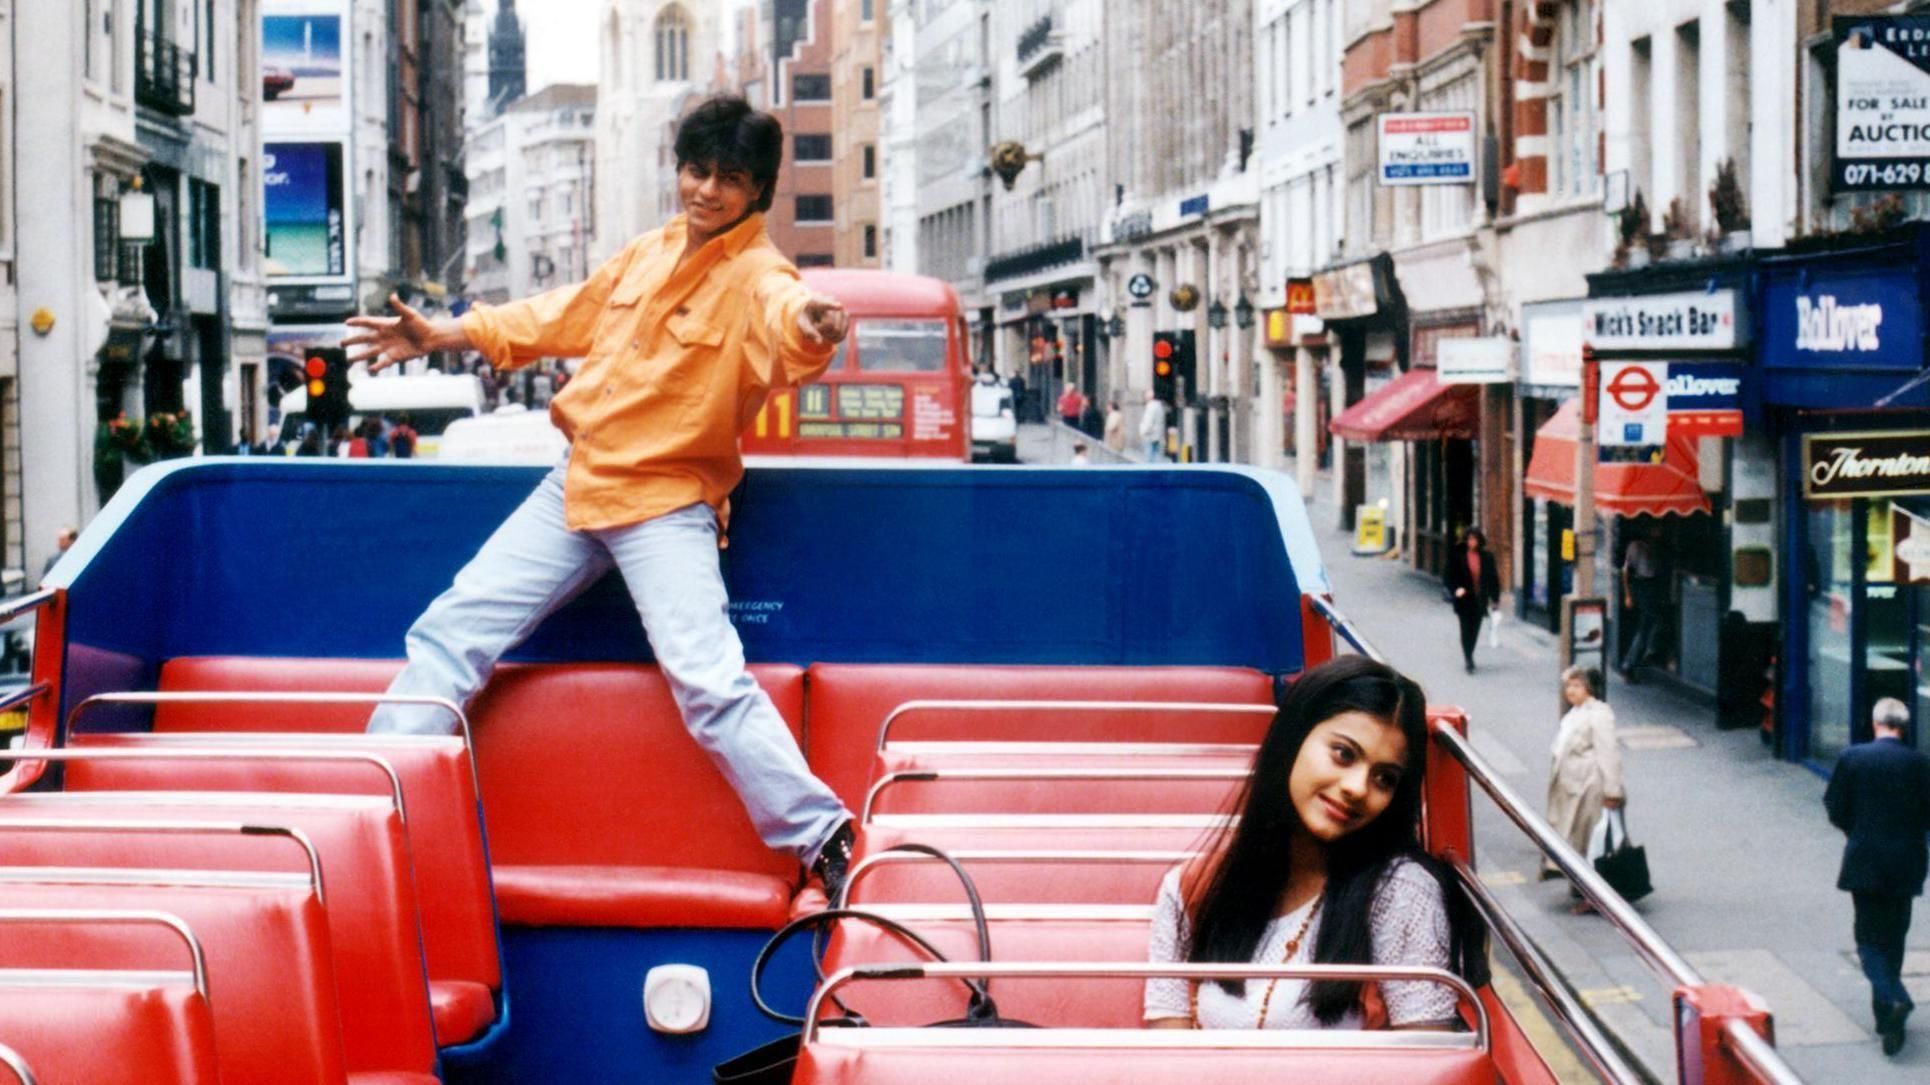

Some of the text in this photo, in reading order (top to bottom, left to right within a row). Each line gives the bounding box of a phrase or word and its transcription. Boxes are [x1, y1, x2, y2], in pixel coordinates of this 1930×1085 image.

[1848, 97, 1927, 111] FOR SALE
[1416, 136, 1438, 146] ALL
[1844, 163, 1921, 185] 071-629
[1638, 309, 1683, 337] Snack
[1688, 306, 1718, 336] Bar
[1796, 294, 1882, 352] Rollover
